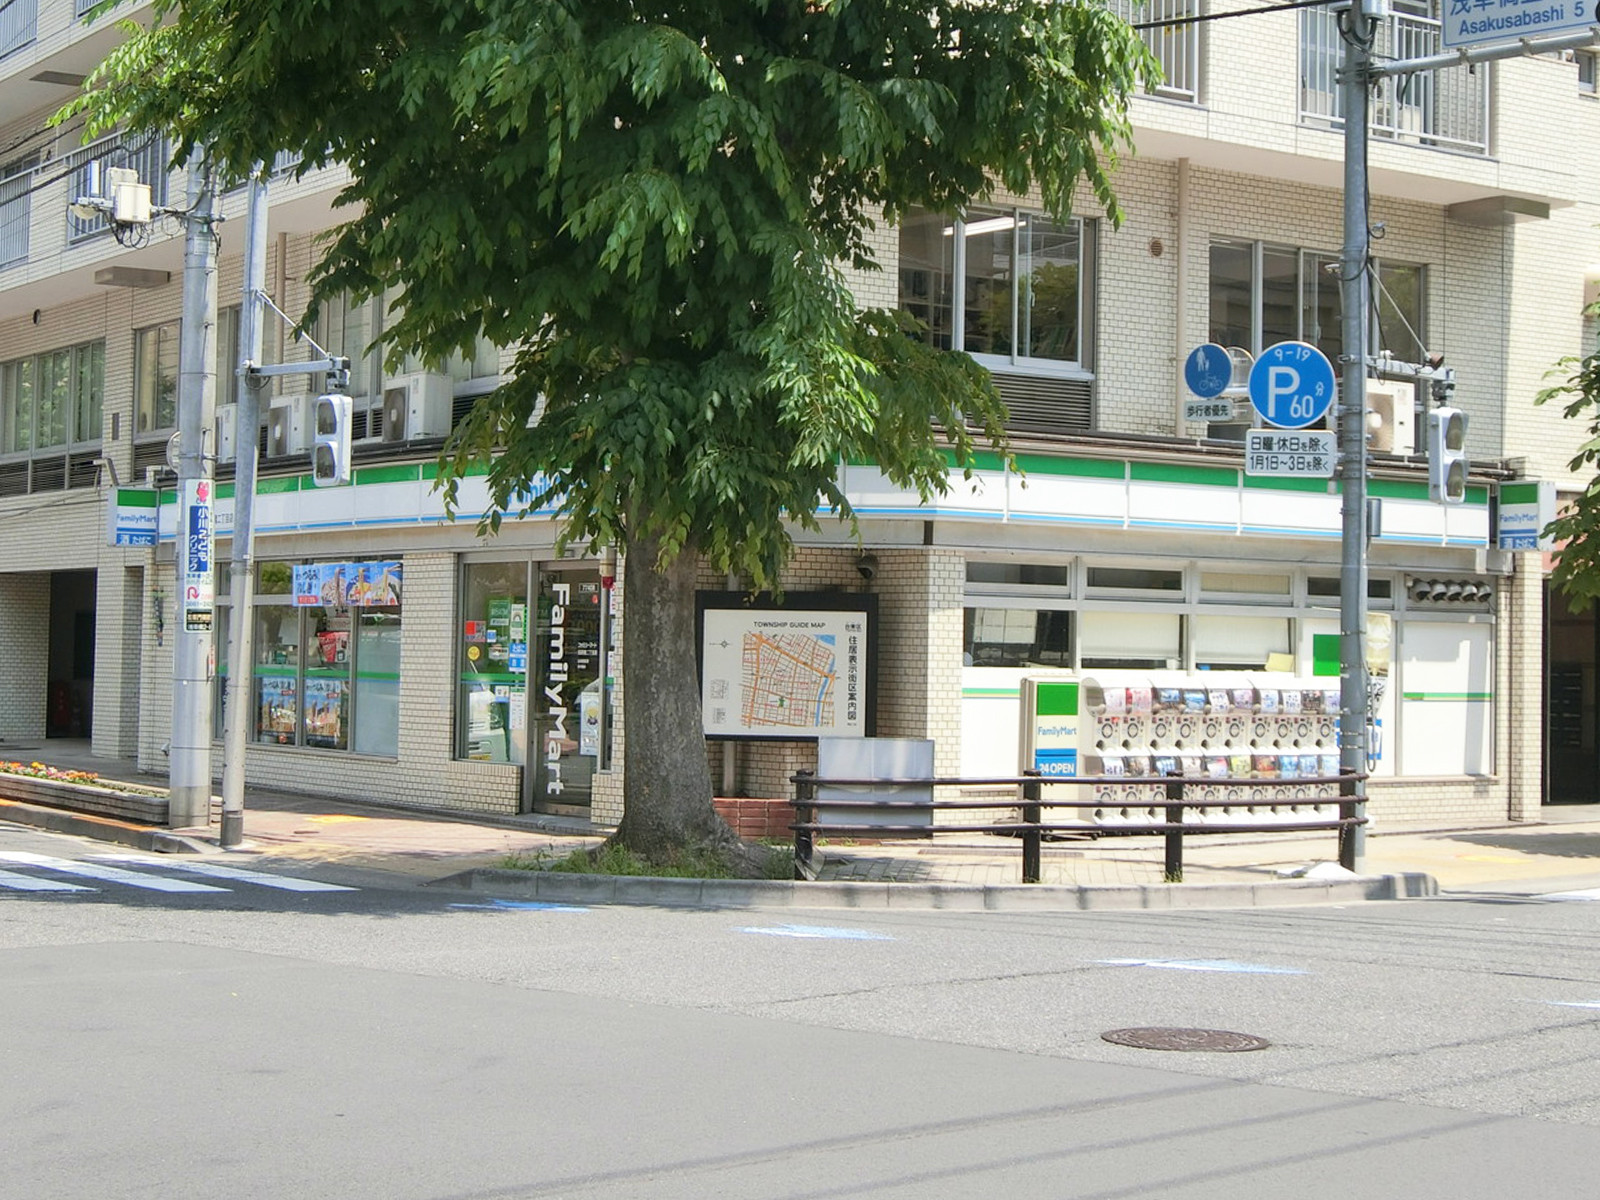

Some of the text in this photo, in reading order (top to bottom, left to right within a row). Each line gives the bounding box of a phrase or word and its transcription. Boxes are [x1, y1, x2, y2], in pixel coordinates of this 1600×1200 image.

[1459, 1, 1585, 36] Asakusabashi 5
[1274, 348, 1311, 361] 9-19
[1268, 366, 1300, 418] P
[1187, 404, 1229, 417] 歩行者優先
[1290, 395, 1314, 418] 60
[1500, 514, 1537, 523] FamilyMar
[545, 583, 570, 795] FamilyMart
[1038, 727, 1077, 737] FamilyMart
[1050, 763, 1075, 774] OPEN
